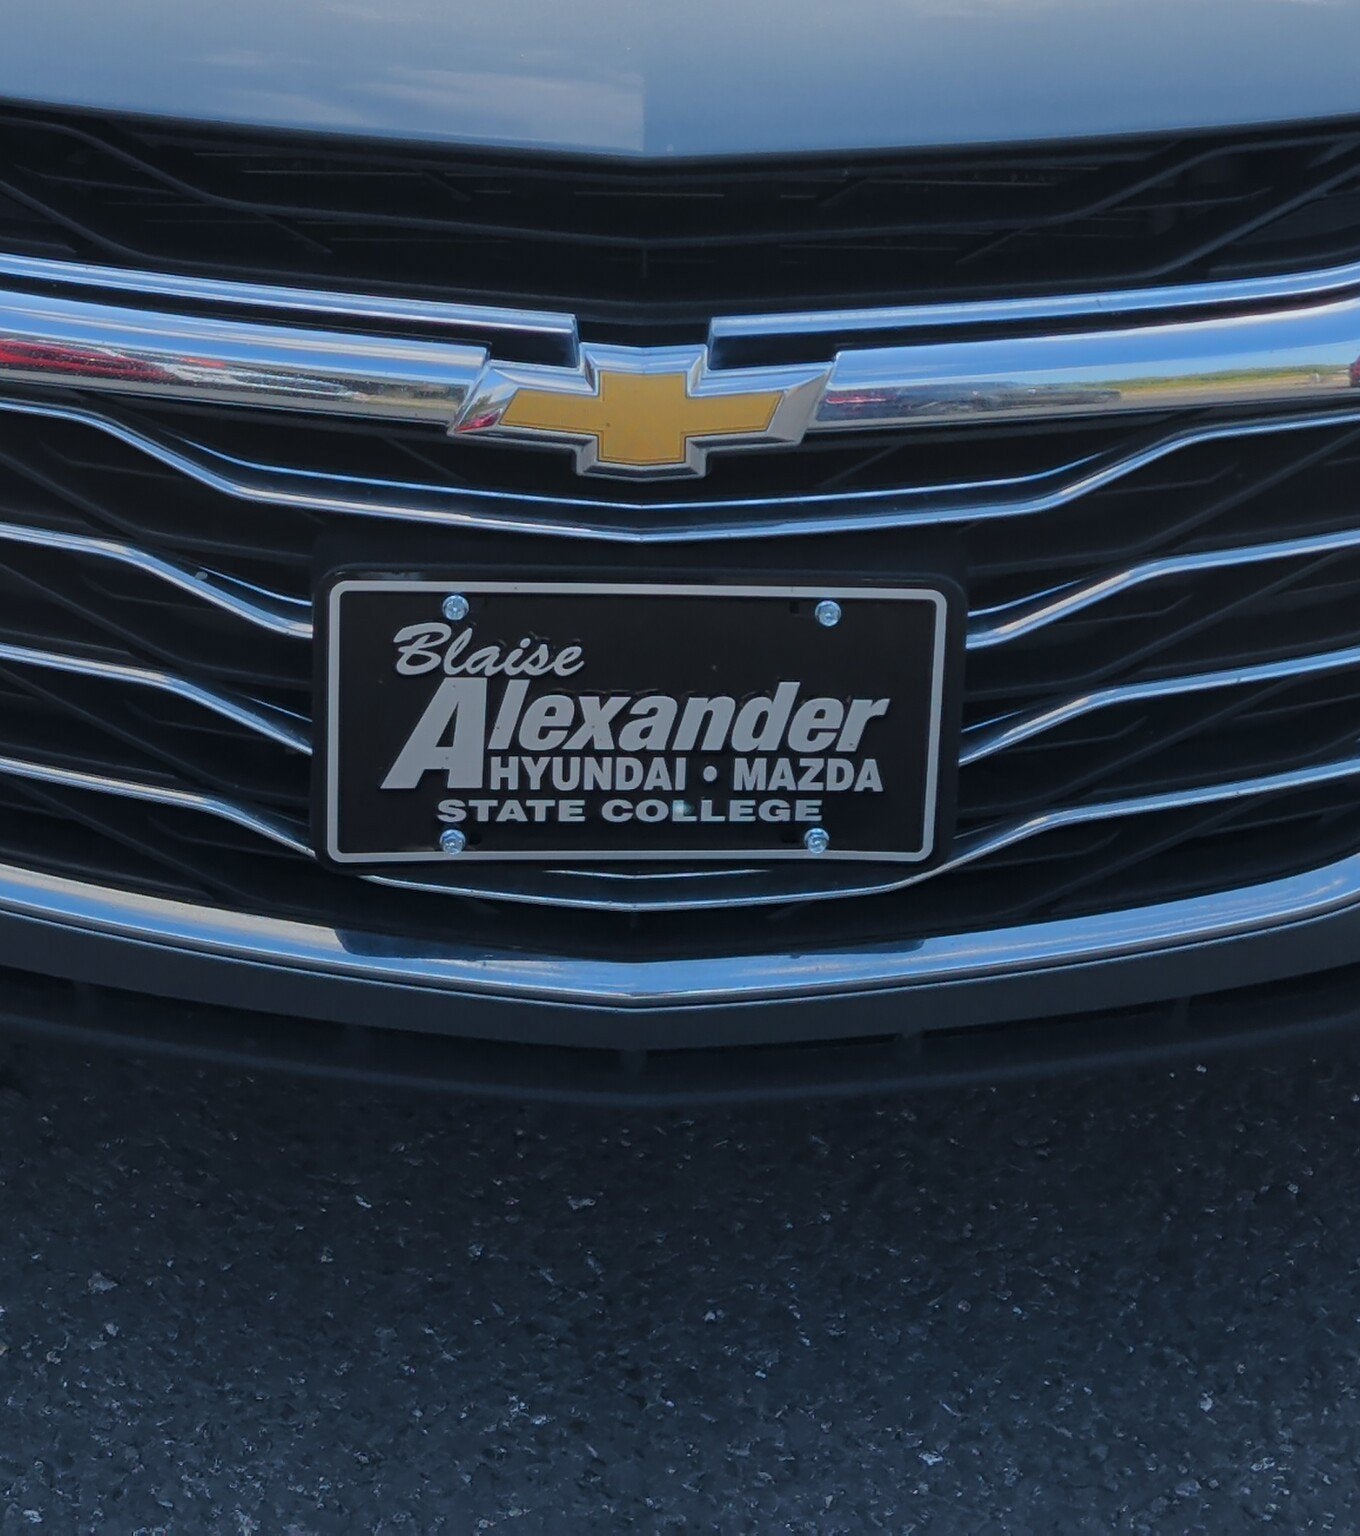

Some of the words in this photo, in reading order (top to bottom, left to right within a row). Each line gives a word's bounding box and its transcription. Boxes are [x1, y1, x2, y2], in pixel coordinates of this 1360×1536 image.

[392, 621, 585, 677] Blaise
[380, 677, 890, 790] Alexander
[490, 756, 686, 792] HYUNDAI
[733, 758, 884, 793] MAZDA
[437, 798, 586, 823] STATE
[601, 798, 823, 823] COLLEGE
